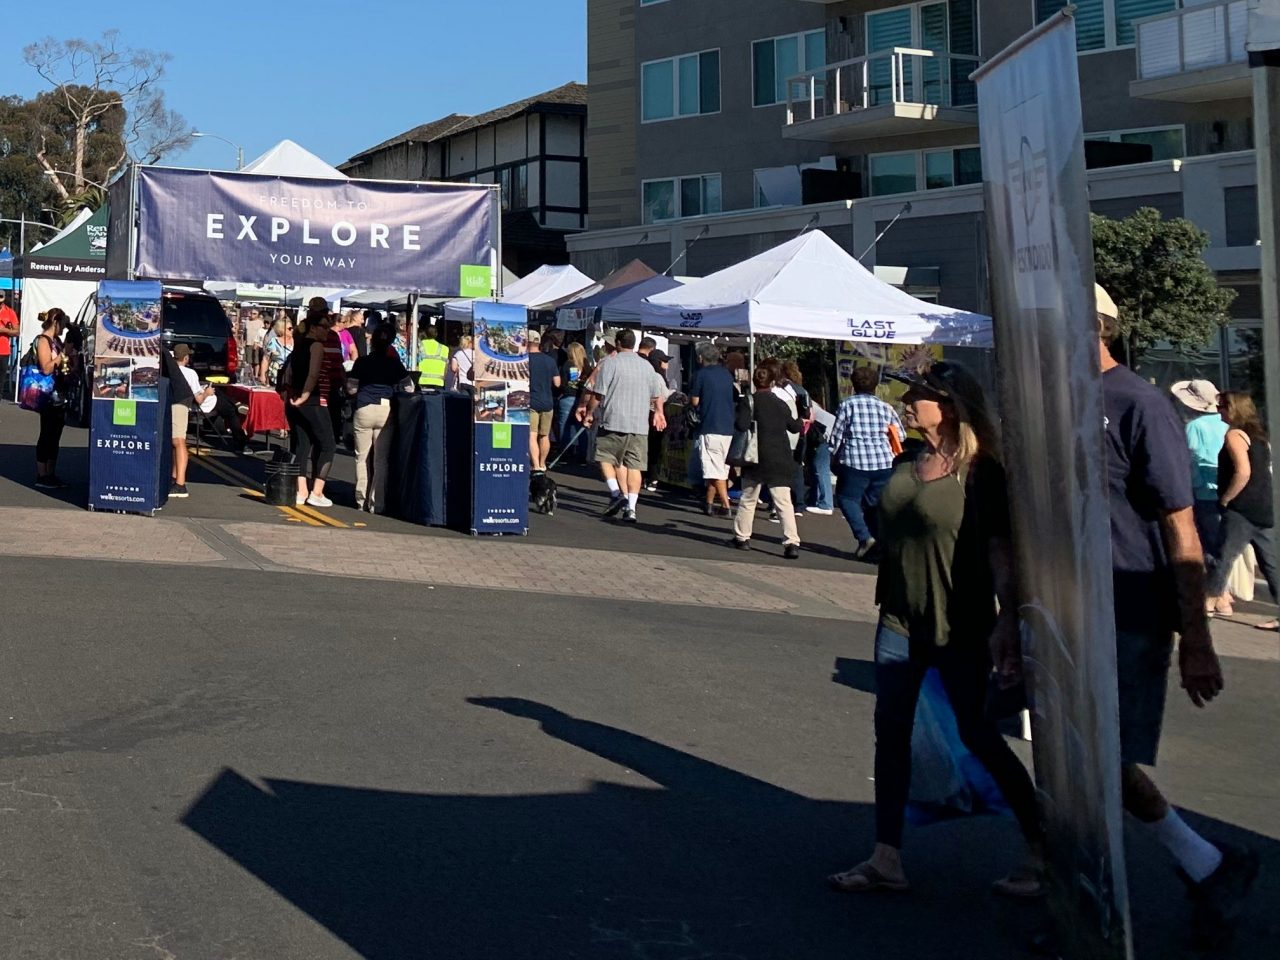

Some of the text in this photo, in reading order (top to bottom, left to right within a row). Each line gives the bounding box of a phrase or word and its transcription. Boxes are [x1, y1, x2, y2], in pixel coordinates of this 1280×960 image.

[259, 196, 368, 212] FREEDOM TO
[206, 213, 421, 250] EXPLORE
[270, 253, 357, 268] YOUR WAY
[30, 262, 106, 274] Renewal by Anderse
[848, 318, 896, 330] LAST
[851, 329, 896, 339] GLUE
[97, 439, 150, 450] EXPLORE
[480, 463, 524, 472] EXPLORE
